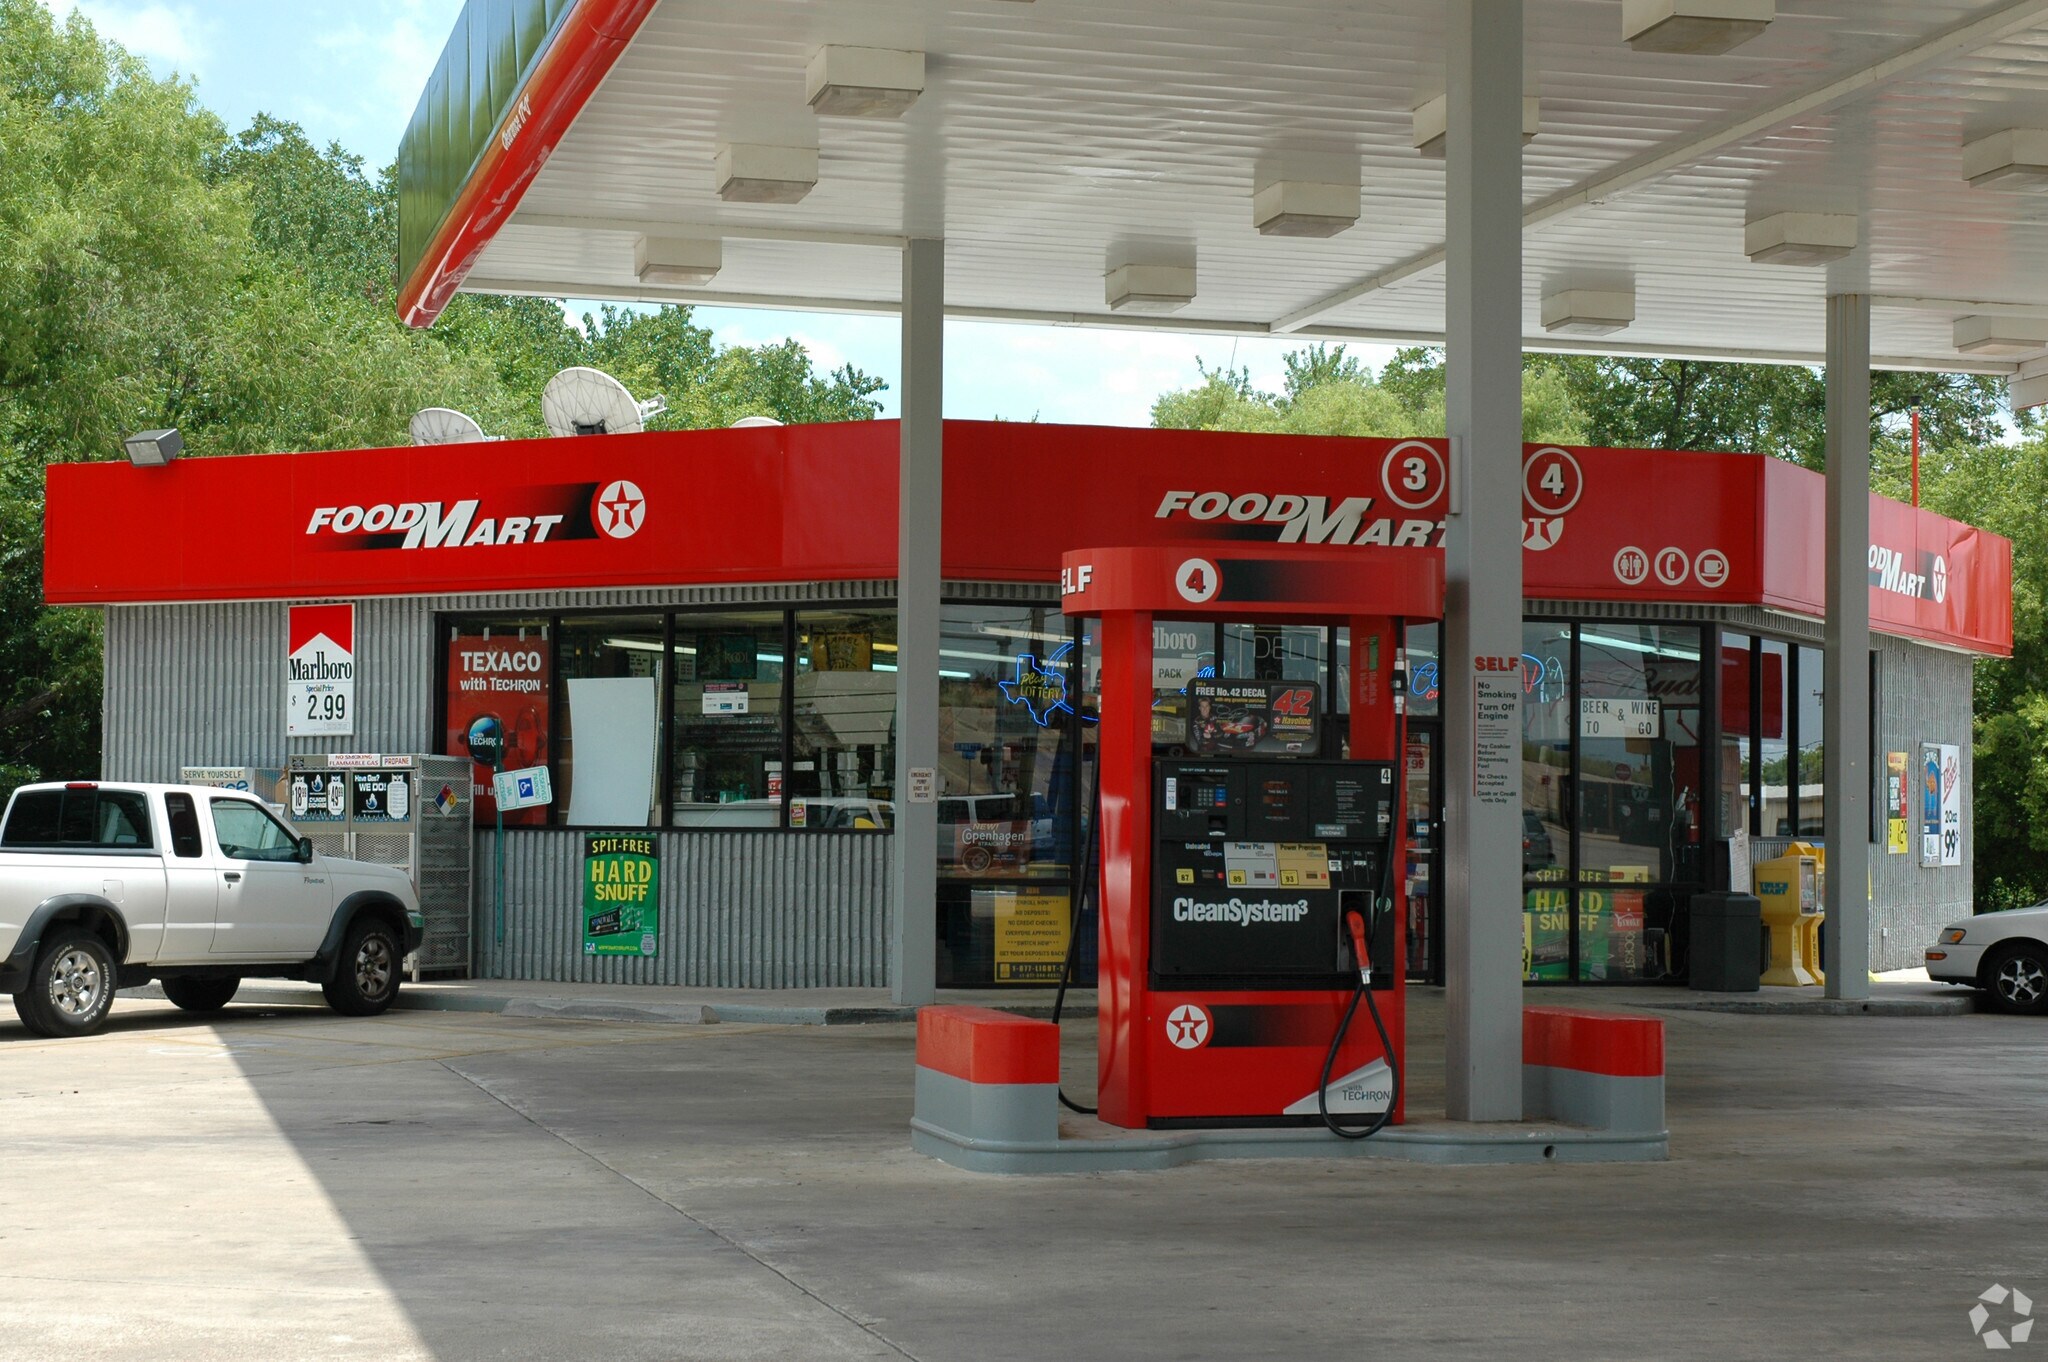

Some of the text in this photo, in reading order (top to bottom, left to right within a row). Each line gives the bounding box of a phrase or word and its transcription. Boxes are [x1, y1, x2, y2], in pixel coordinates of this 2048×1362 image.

[1402, 457, 1427, 491] 3
[1540, 463, 1565, 495] 4
[1185, 567, 1207, 594] 4
[1152, 626, 1197, 650] lboro
[1254, 636, 1308, 660] DELI
[289, 651, 352, 680] Marlboro
[460, 651, 541, 672] TEXACO
[1474, 656, 1519, 672] SELF
[1159, 668, 1182, 679] PACK
[460, 677, 541, 693] with TECHRON
[1020, 685, 1060, 699] LOTTERY
[1195, 686, 1215, 696] FREE
[1231, 688, 1241, 697] 42
[1242, 688, 1267, 698] DECAL
[1477, 682, 1490, 690] No
[1272, 689, 1313, 716] 42
[1477, 690, 1517, 700] Smoking
[307, 694, 345, 720] 2.99
[1477, 703, 1515, 711] Turn Off
[1582, 701, 1657, 721] BEER & WINE
[1281, 717, 1312, 726] Havoline
[1477, 712, 1509, 721] Engine
[1585, 720, 1652, 735] TO GO
[384, 757, 410, 765] PROPANE
[184, 770, 243, 779] SERVE YOURSELF
[1382, 769, 1390, 783] 4
[359, 783, 387, 792] WE DO!
[972, 823, 999, 831] NEW!
[962, 828, 1025, 847] Copenhagen
[592, 839, 650, 854] SPIT-FREE
[591, 860, 652, 883] HARD
[1286, 875, 1294, 883] 93
[1536, 869, 1602, 882] SPITREE
[594, 883, 649, 901] SNUFF
[97, 962, 110, 1009] PHANTOM
[1342, 1089, 1391, 1102] TECHRON
